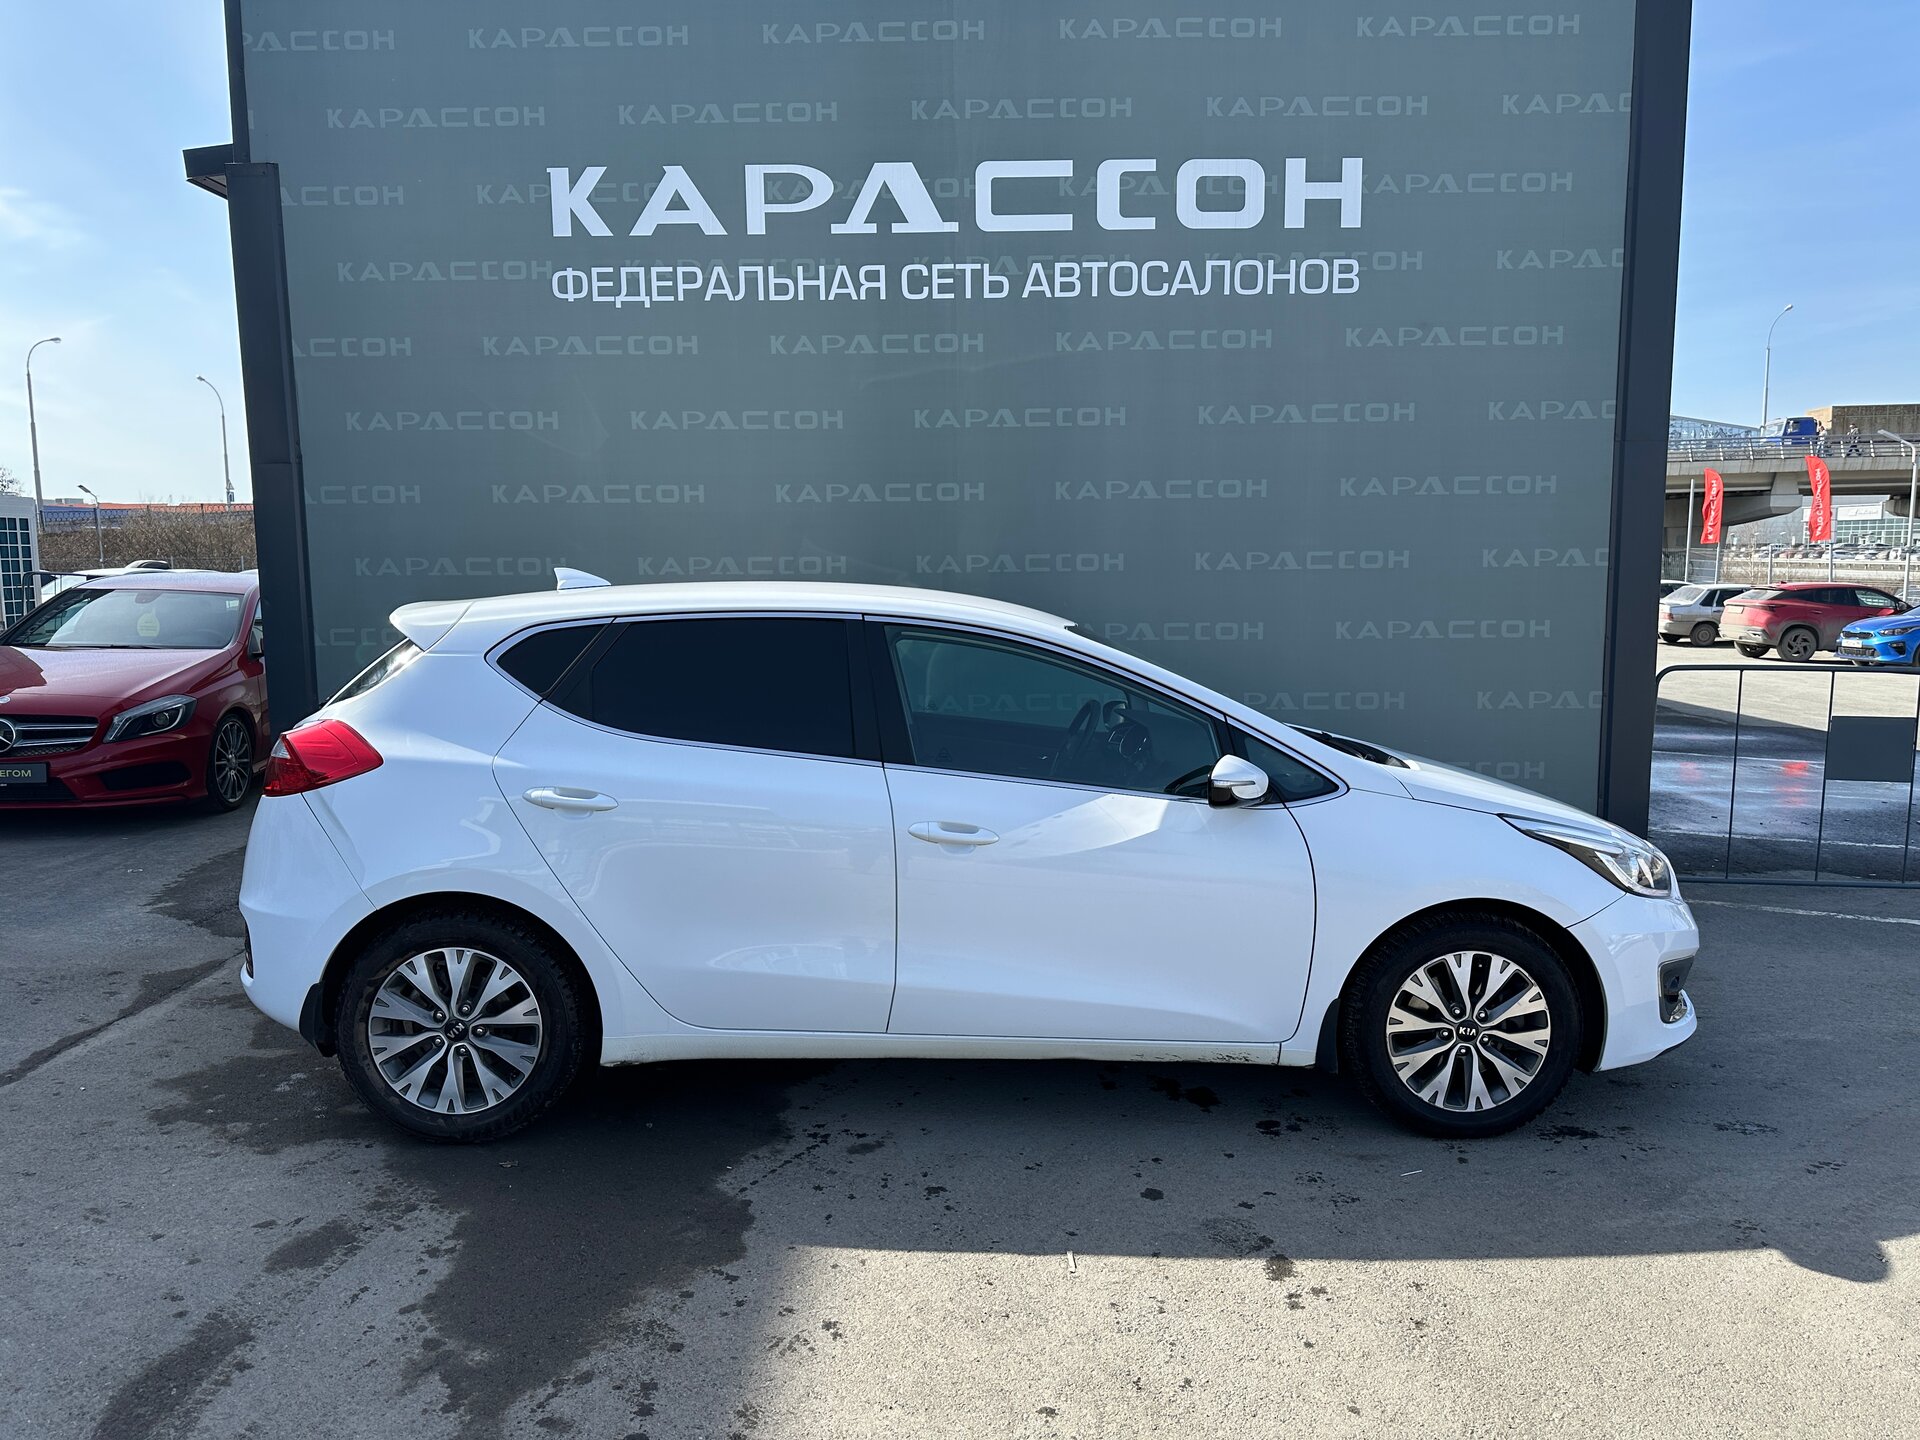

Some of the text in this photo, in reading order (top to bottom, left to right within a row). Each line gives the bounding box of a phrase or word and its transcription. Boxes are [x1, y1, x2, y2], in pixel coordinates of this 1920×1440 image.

[551, 258, 1360, 308] ФЕДЕРАЛЬНАЯ СЕТЬ АВТОСАЛОНОВ
[447, 1022, 465, 1038] KIA
[1458, 1026, 1477, 1036] KIA
